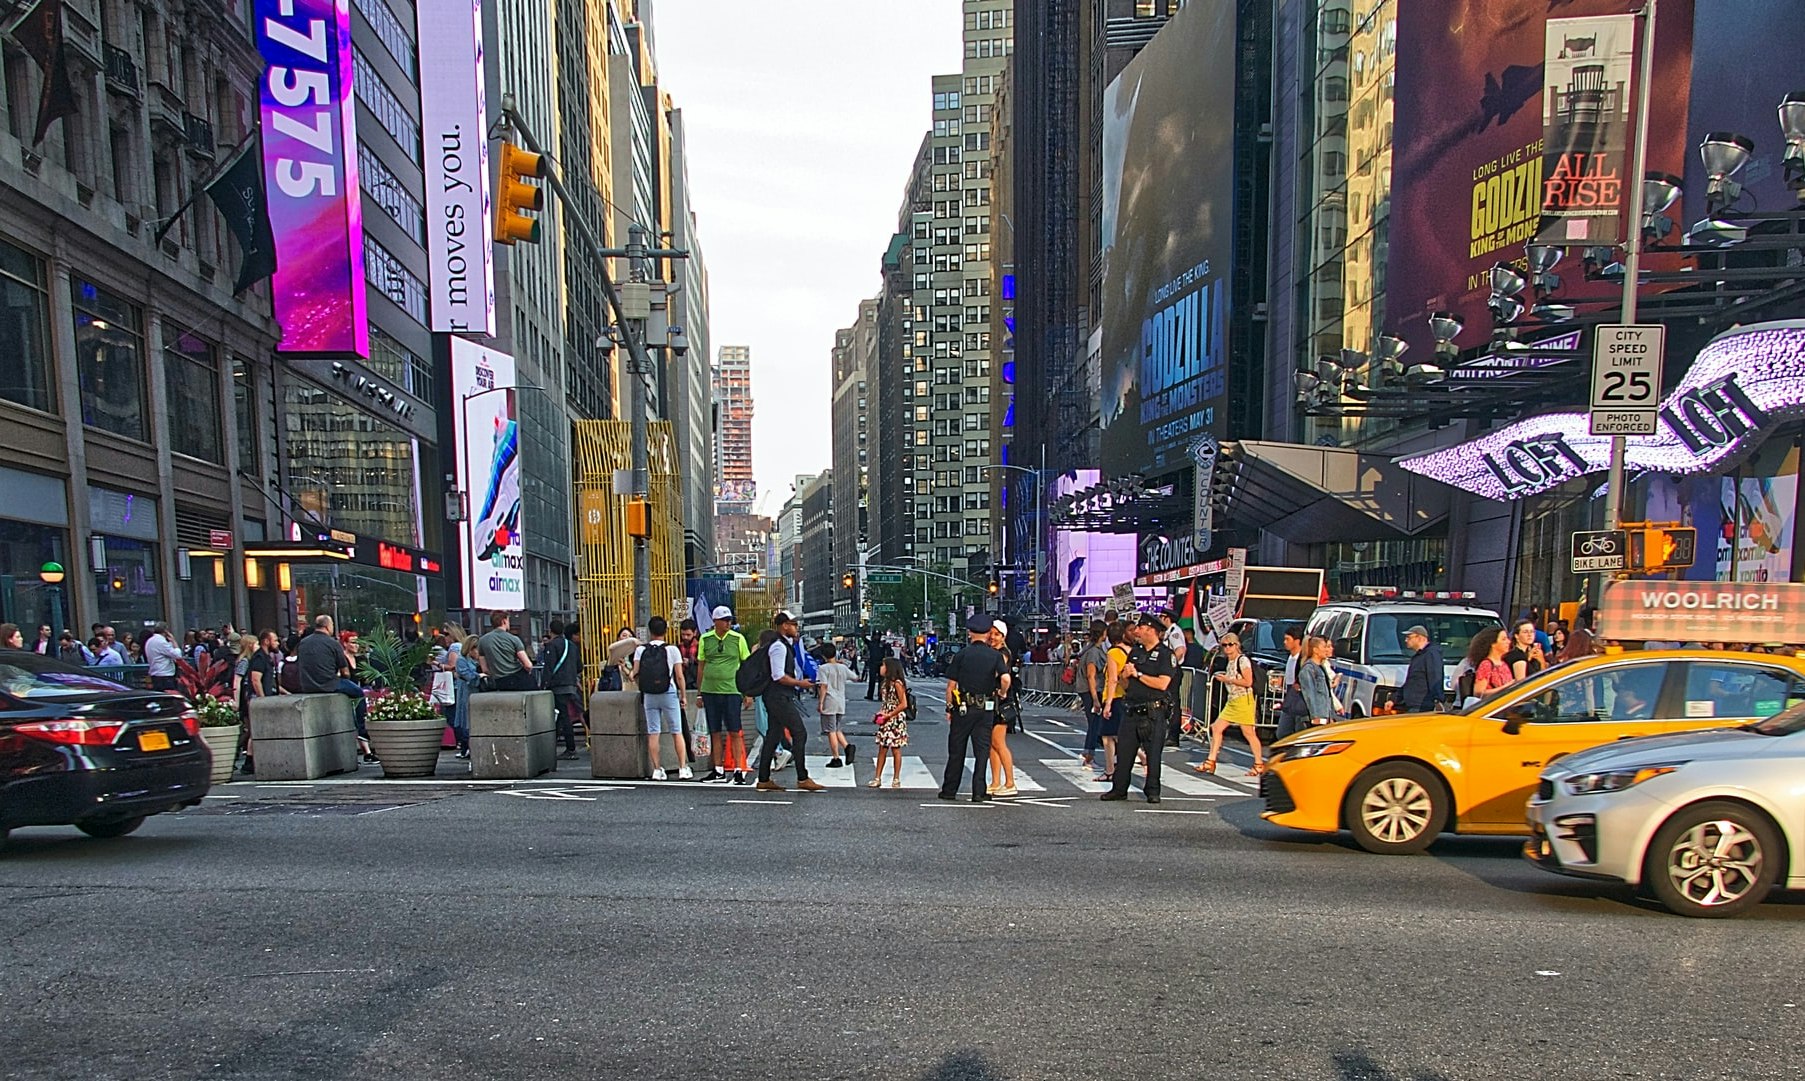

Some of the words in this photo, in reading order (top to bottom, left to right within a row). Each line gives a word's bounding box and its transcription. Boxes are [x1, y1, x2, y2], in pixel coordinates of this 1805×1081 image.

[442, 123, 473, 194] you.
[1473, 160, 1498, 181] LONG
[1501, 148, 1521, 168] LIVE
[1525, 138, 1544, 157] THE
[1552, 153, 1616, 181] ALL
[1543, 179, 1621, 208] RISE
[1470, 233, 1495, 259] KING
[1506, 217, 1540, 247] MONS
[445, 203, 469, 307] moves
[1155, 285, 1170, 304] LONG
[1182, 269, 1193, 287] THE
[1468, 274, 1478, 291] IN
[1141, 278, 1224, 399] GODZILLA
[1609, 343, 1647, 354] SPEED
[1615, 331, 1643, 341] CITY
[1612, 356, 1643, 367] LIMIT
[1169, 371, 1224, 415] MONSTERS
[1601, 371, 1652, 401] 25
[1156, 416, 1189, 443] THEATERS
[1189, 410, 1205, 430] MAY
[1205, 407, 1214, 425] 31
[1595, 422, 1651, 432] ENFORCED
[1606, 413, 1641, 423] PHOTO
[1658, 371, 1772, 457] LOFT
[1482, 432, 1592, 494] LOFT
[1198, 478, 1209, 547] COUNTER
[492, 547, 523, 569] airmax
[1146, 545, 1160, 573] THE
[1574, 559, 1596, 570] BIKE
[1597, 557, 1624, 569] LANE
[489, 572, 520, 593] airmax
[1641, 591, 1779, 610] WOOLRICH
